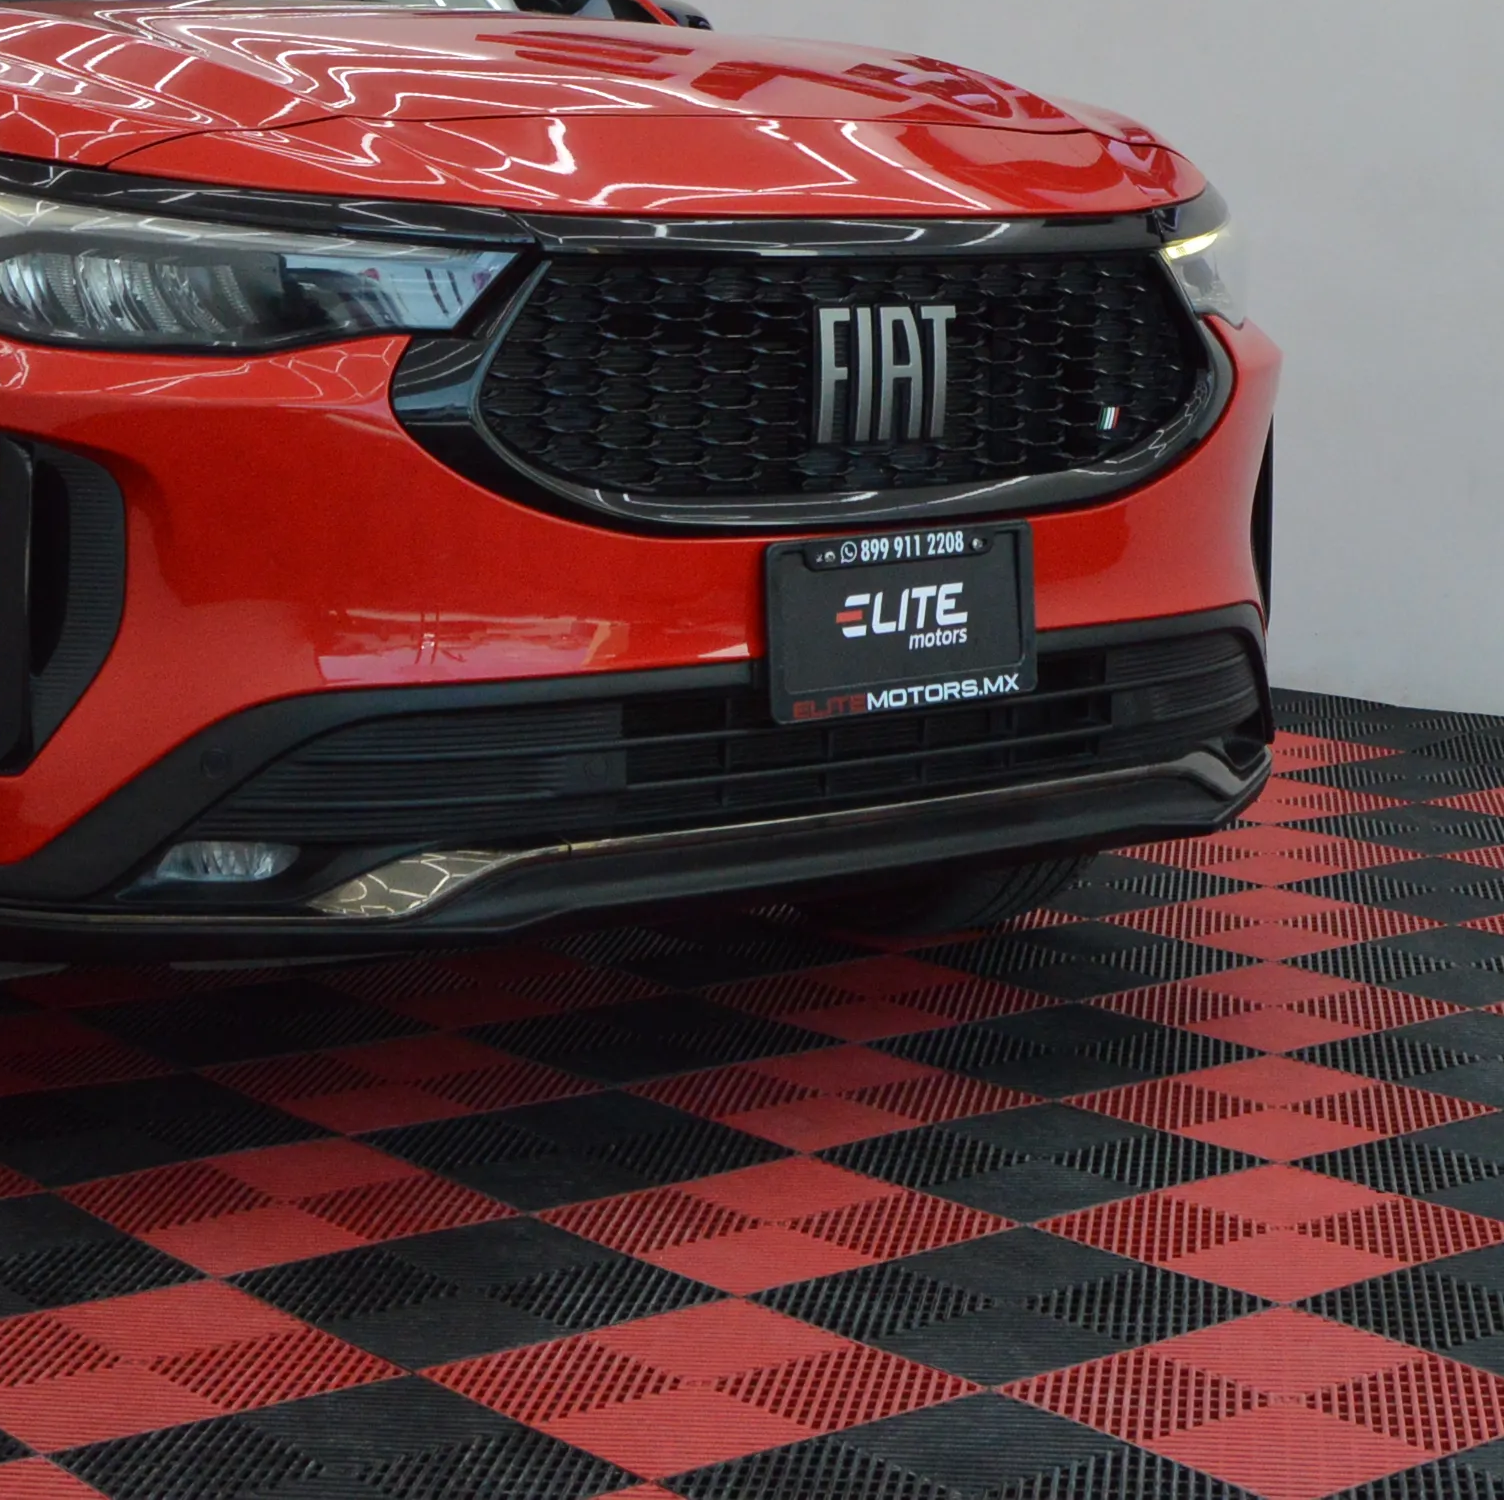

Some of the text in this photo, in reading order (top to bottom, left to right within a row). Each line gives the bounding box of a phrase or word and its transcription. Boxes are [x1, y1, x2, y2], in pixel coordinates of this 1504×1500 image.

[816, 304, 957, 444] FIAT
[860, 530, 964, 562] 899 911 2208
[835, 582, 969, 638] ELITE
[909, 627, 968, 650] motors
